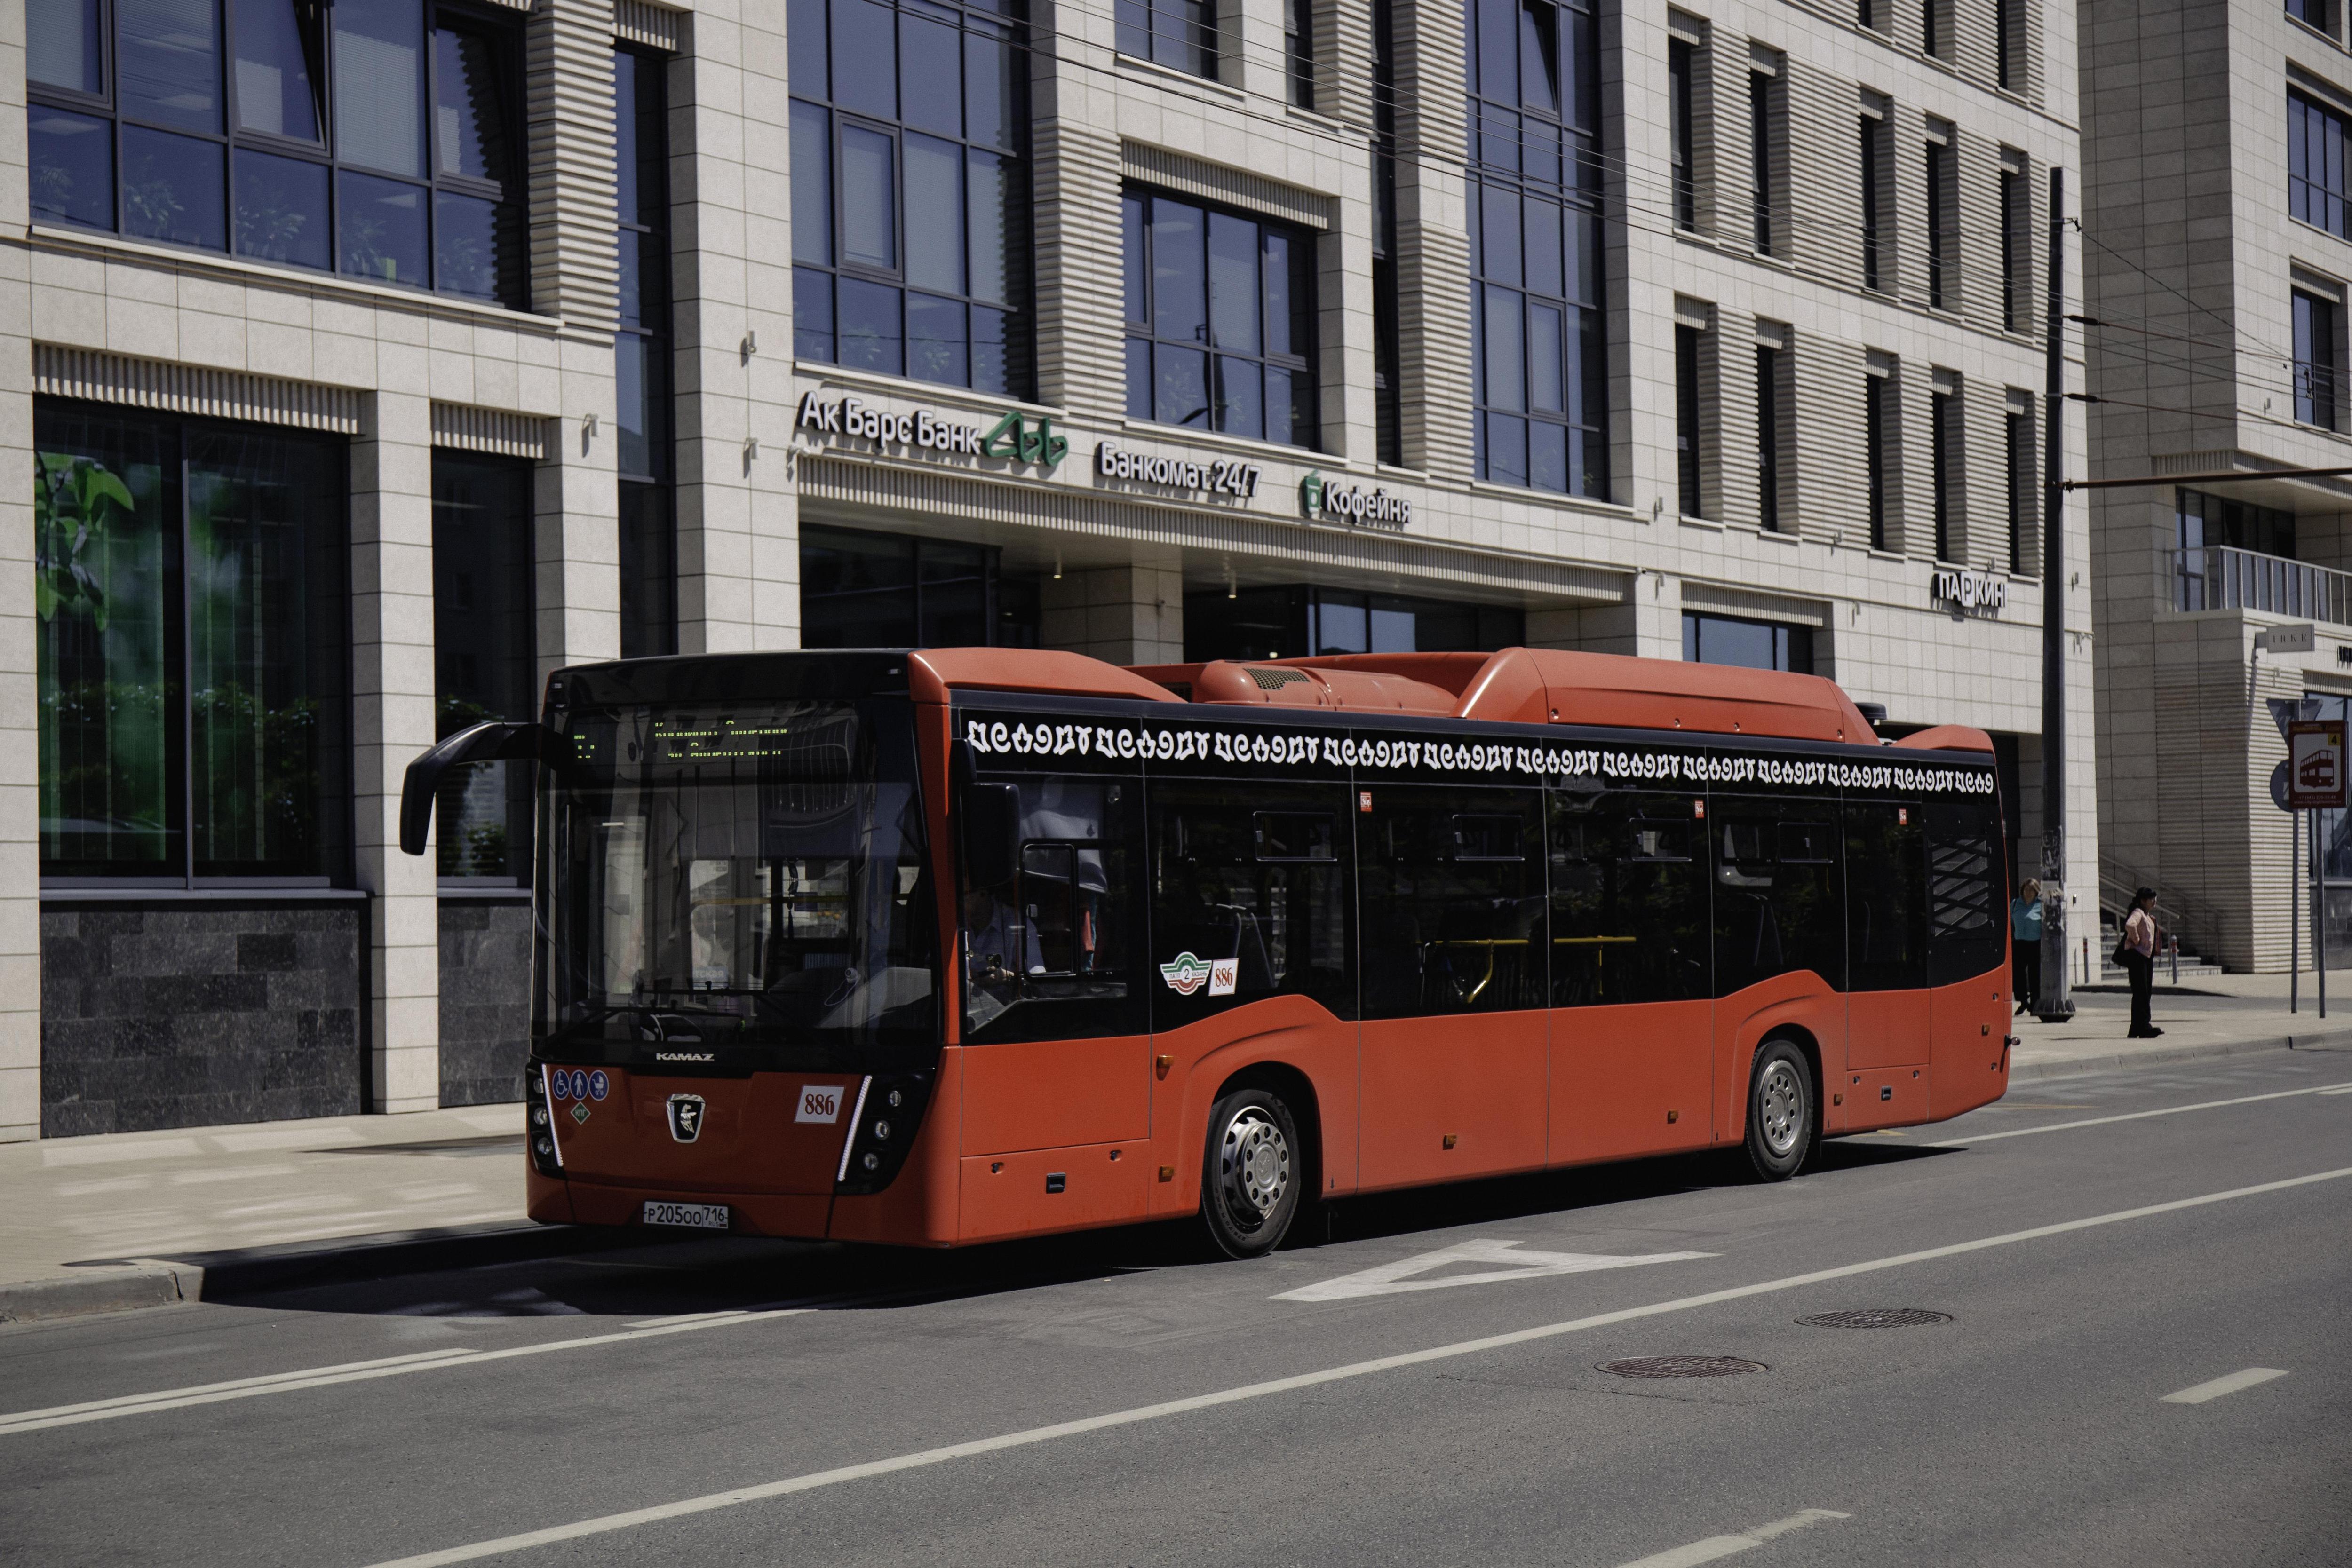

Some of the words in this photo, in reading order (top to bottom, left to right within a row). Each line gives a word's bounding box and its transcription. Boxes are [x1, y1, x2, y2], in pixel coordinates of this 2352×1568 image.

[801, 390, 841, 433] Ак
[845, 397, 912, 449] Барс
[917, 410, 981, 455] Банк
[1100, 441, 1208, 491] Банкомат
[1214, 461, 1262, 498] 24/7
[1325, 481, 1412, 524] Кофейня
[2331, 735, 2337, 744] 4
[1184, 969, 1190, 979] 2
[1216, 967, 1233, 987] 886
[656, 1053, 715, 1061] KAMAZ
[805, 1093, 835, 1116] 886
